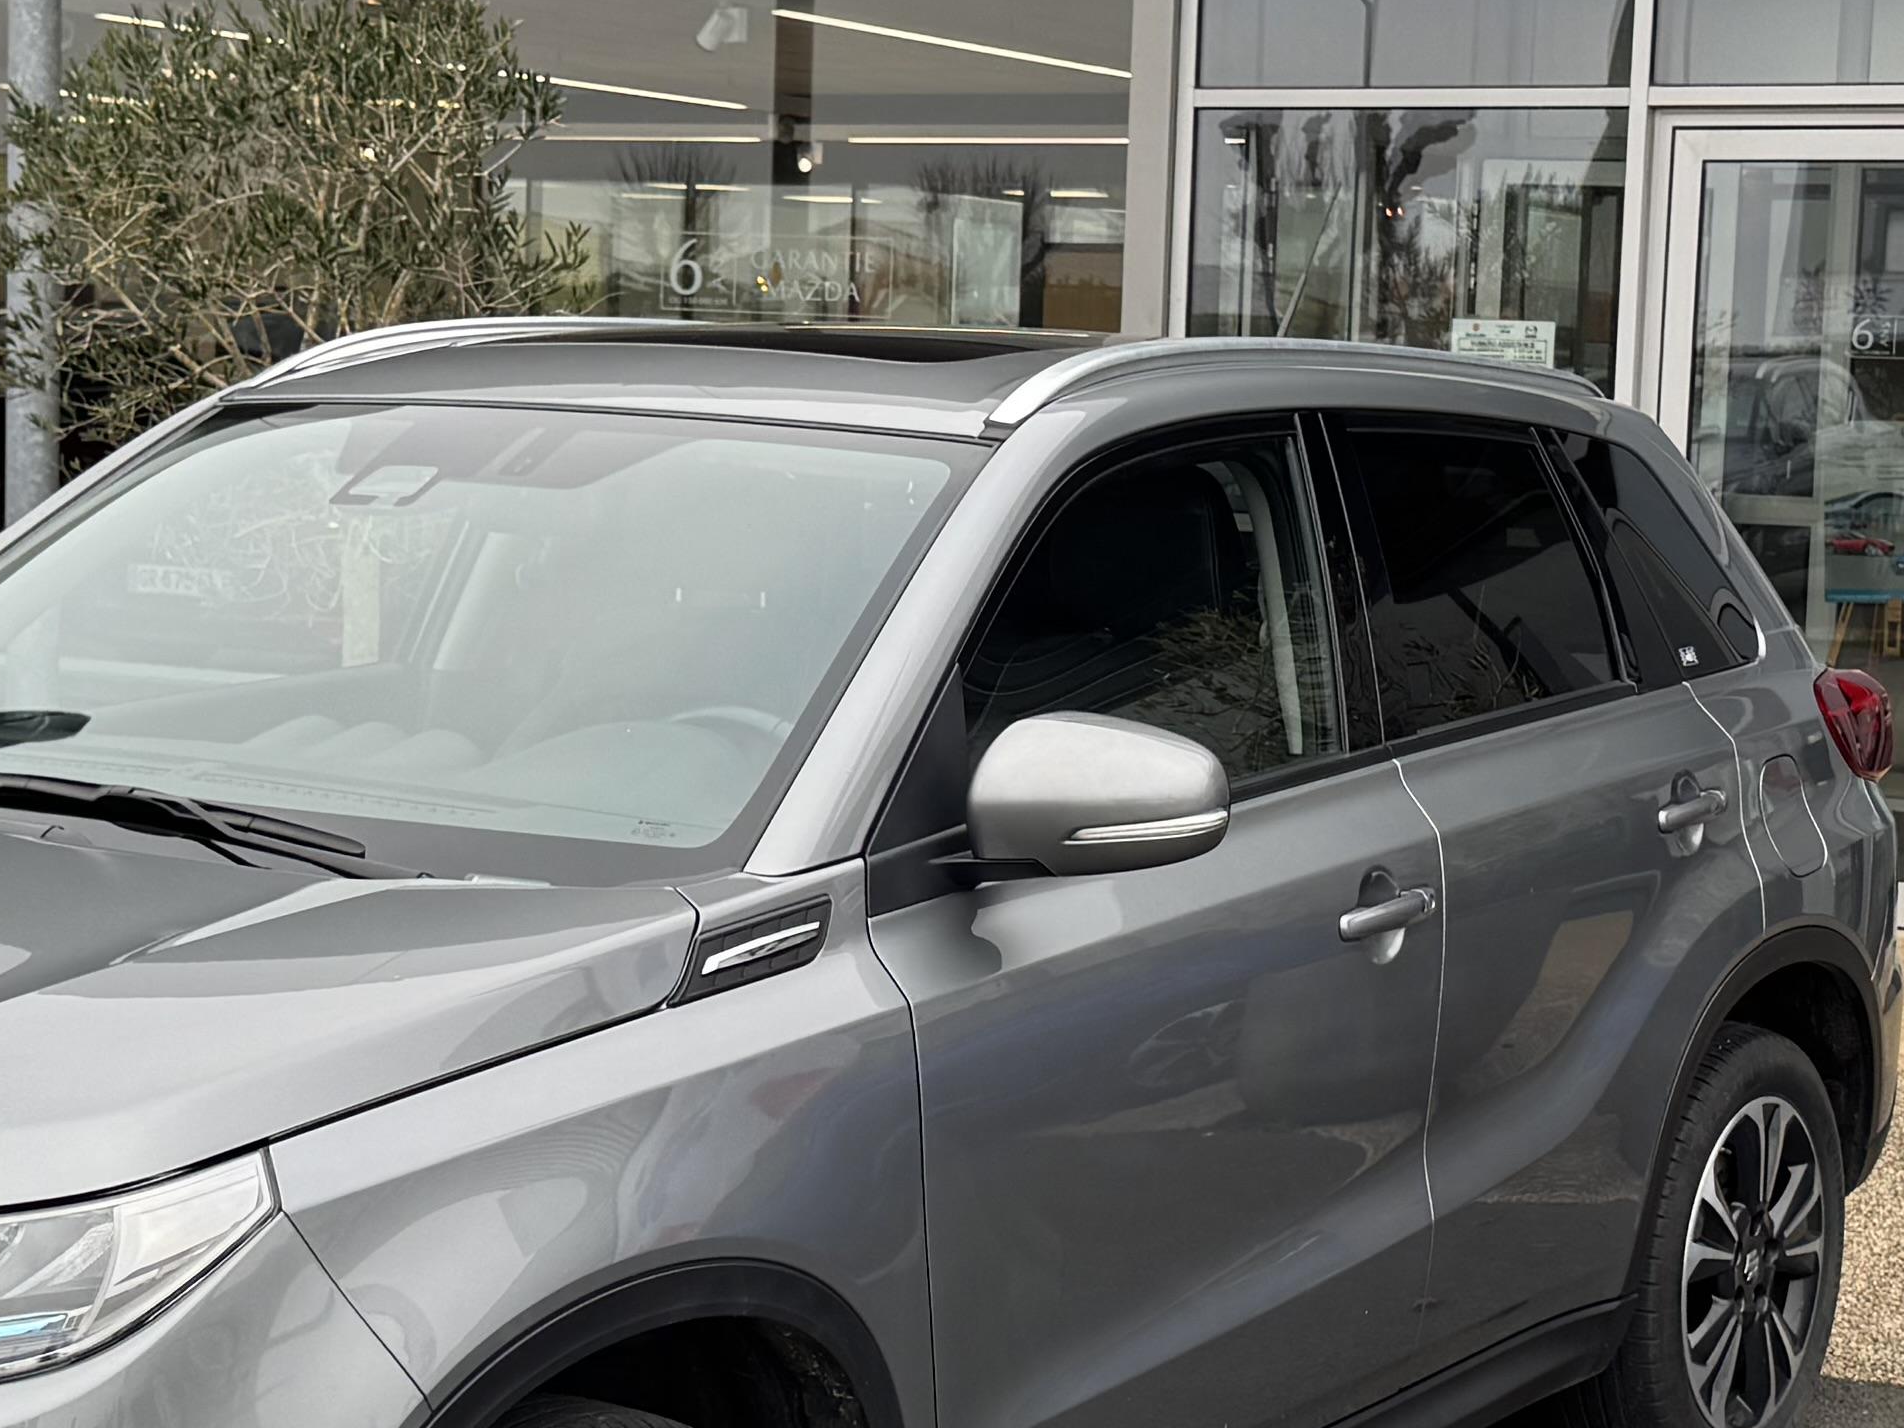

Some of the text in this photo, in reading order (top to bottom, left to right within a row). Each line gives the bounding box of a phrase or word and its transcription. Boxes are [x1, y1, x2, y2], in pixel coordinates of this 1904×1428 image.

[670, 238, 703, 296] 6
[751, 248, 874, 273] GARANTIE
[767, 278, 861, 303] MAZDA
[1852, 318, 1874, 350] 6
